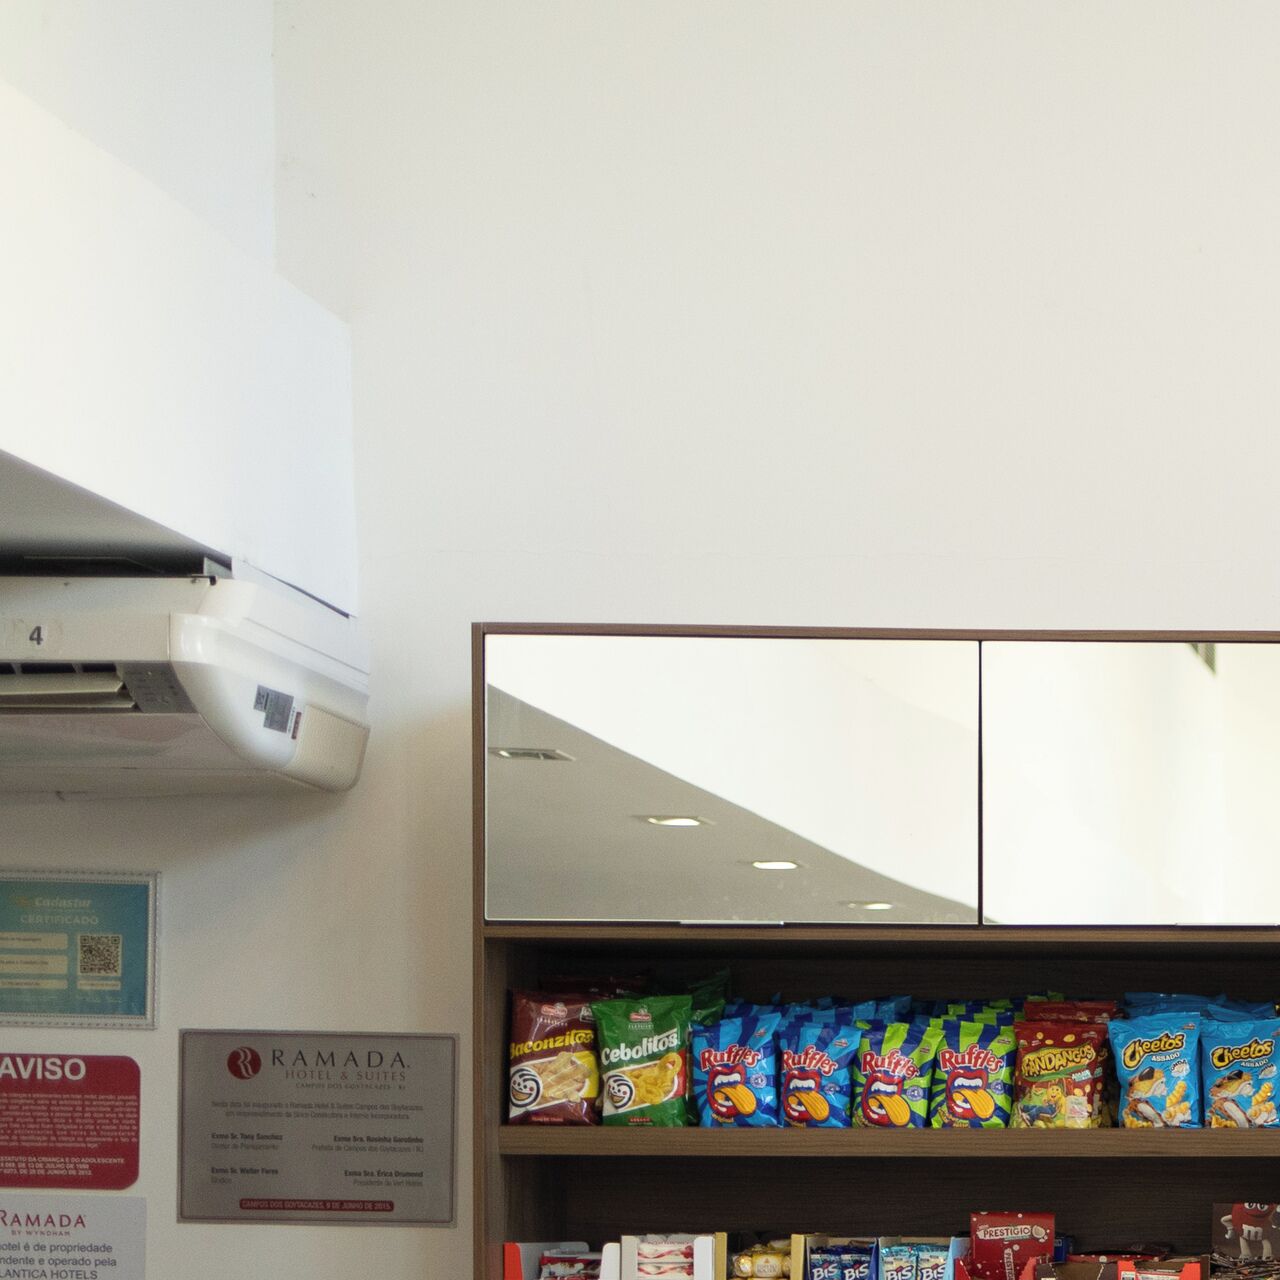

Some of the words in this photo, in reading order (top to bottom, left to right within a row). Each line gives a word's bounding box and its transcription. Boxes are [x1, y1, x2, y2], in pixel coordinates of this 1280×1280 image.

[29, 626, 43, 645] 4
[21, 914, 98, 925] CERTIFICADO
[601, 1027, 680, 1065] Cebolitos
[1123, 1032, 1186, 1070] Cheetos
[1212, 1039, 1274, 1070] Cheetos
[272, 1049, 405, 1069] RAMADA
[701, 1046, 761, 1072] Ruffles
[782, 1046, 837, 1075] Ruffles
[861, 1049, 919, 1079] Ruffles
[939, 1044, 1004, 1074] Ruffles
[1021, 1043, 1096, 1076] FANDANGOS
[1151, 1052, 1180, 1062] ASSADO
[0, 1057, 86, 1080] AVISO
[286, 1070, 332, 1081] HOTEL
[340, 1070, 348, 1081] &
[357, 1071, 406, 1081] SUITES
[0, 1210, 86, 1228] RAMADA
[983, 1227, 1031, 1239] PRESTIGIO
[1242, 1223, 1263, 1241] m
[34, 1242, 46, 1251] de
[50, 1243, 112, 1254] propriedade
[48, 1258, 91, 1267] operado
[94, 1258, 117, 1267] pela
[51, 1270, 98, 1280] HOTELS
